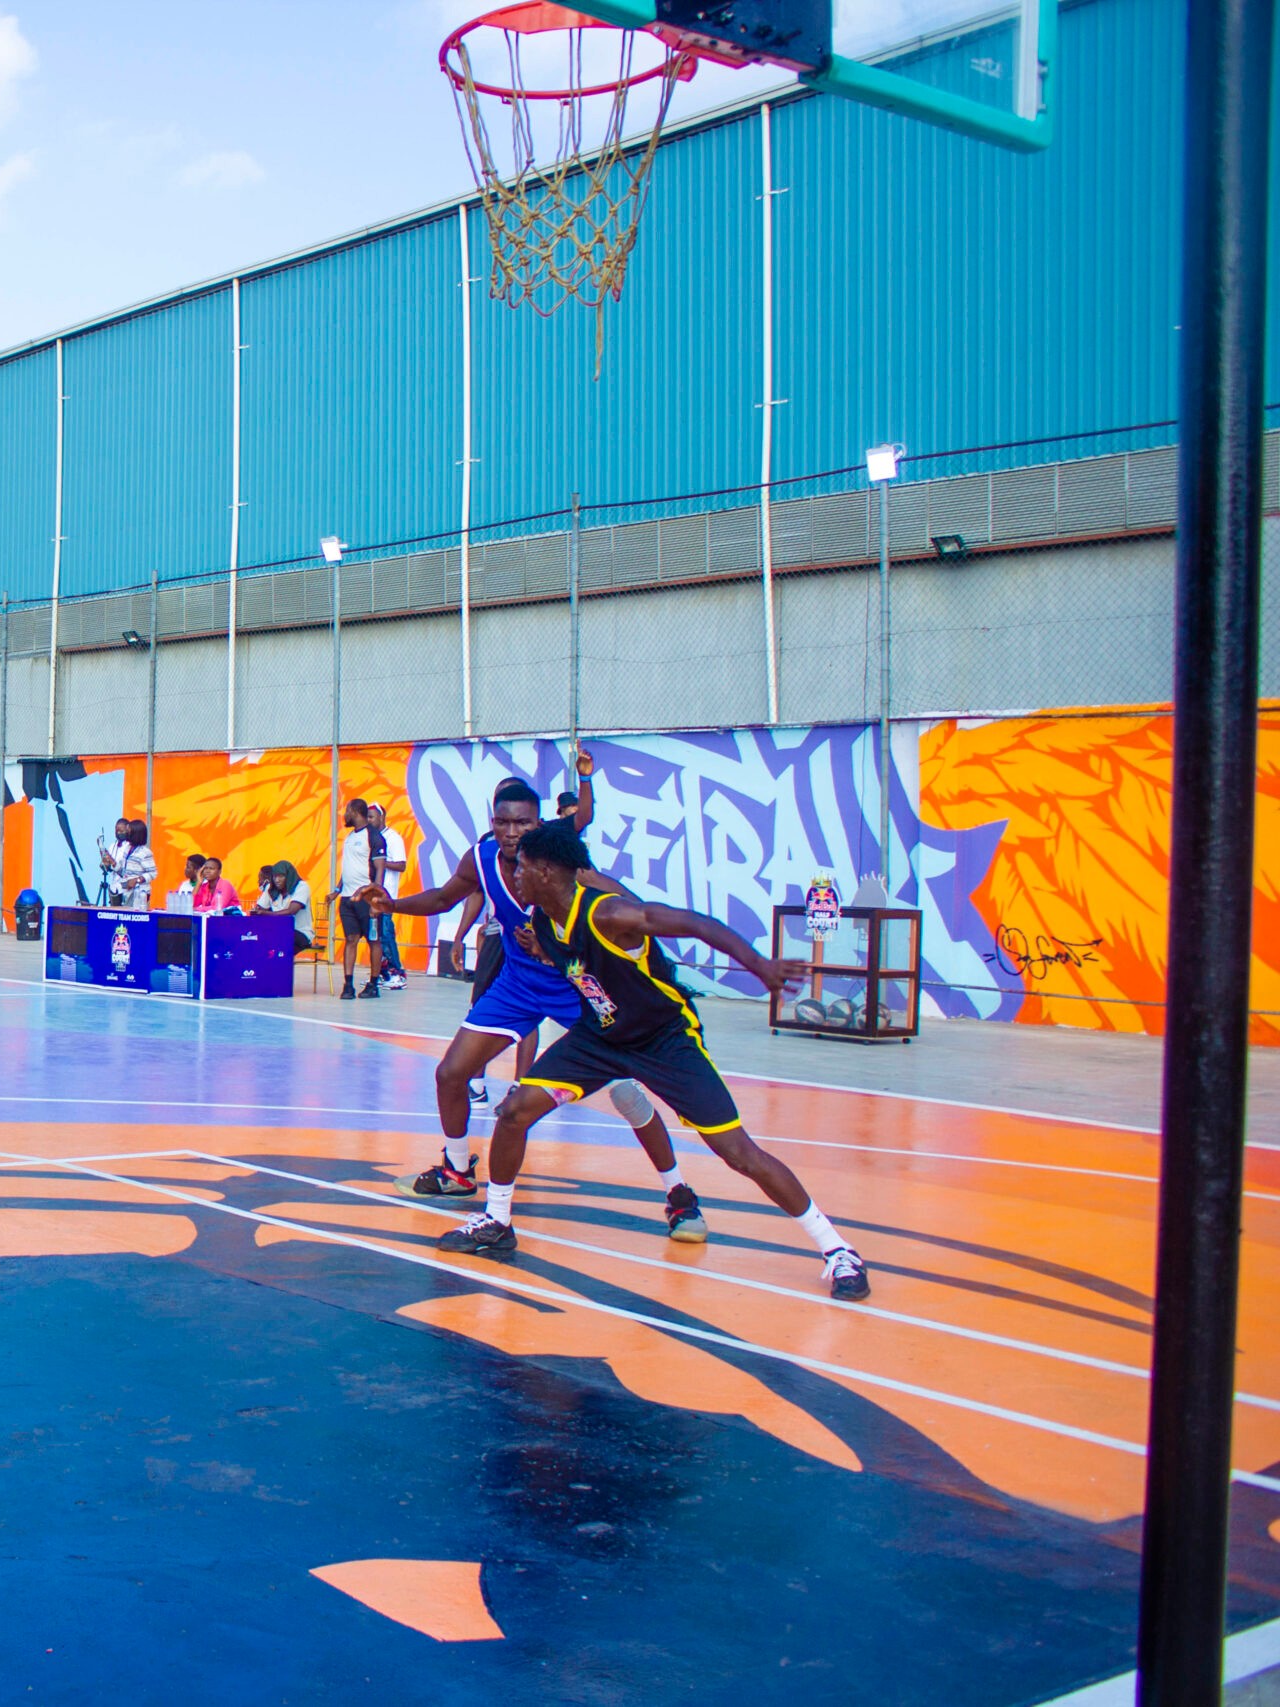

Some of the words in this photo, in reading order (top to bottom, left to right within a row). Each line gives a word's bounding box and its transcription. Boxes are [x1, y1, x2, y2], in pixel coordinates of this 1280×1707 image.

[97, 912, 118, 920] CURRENT
[118, 913, 131, 921] TEAM
[131, 914, 150, 922] SCORES
[807, 917, 838, 930] COURT
